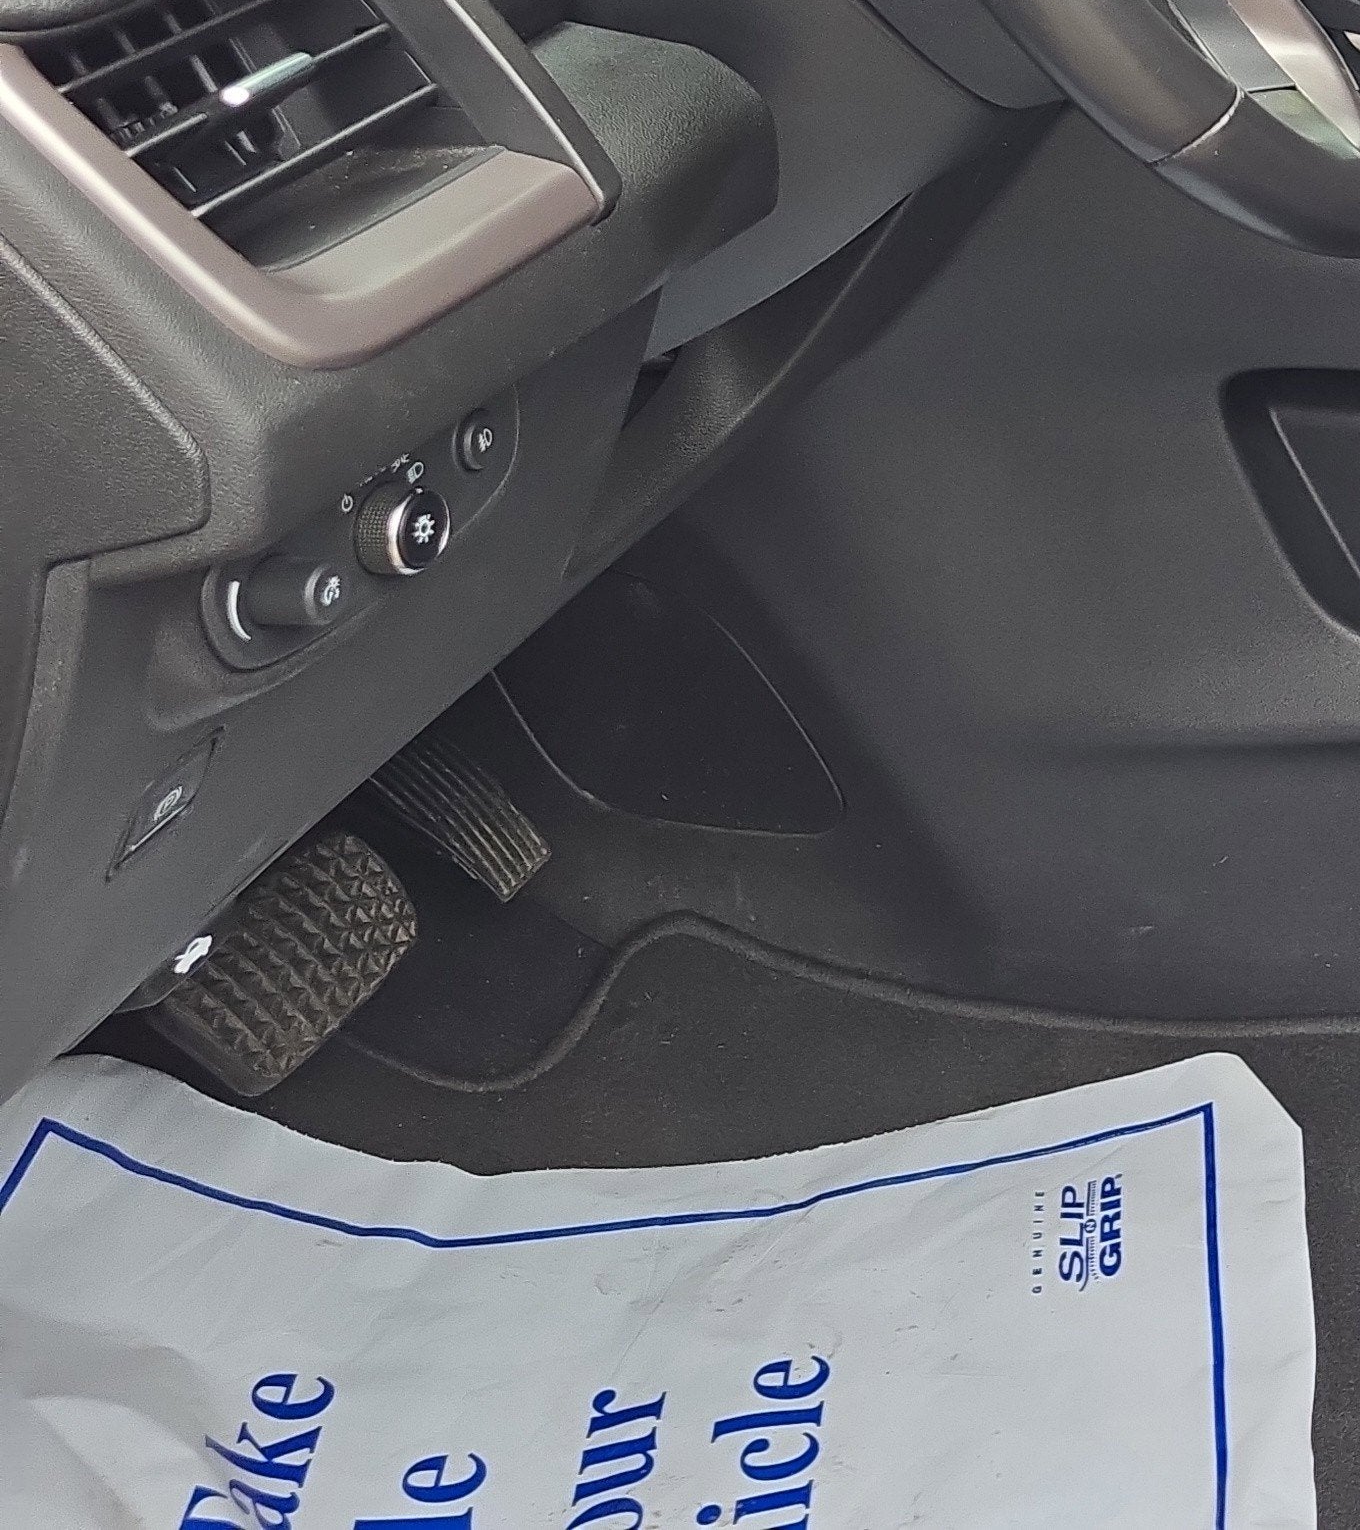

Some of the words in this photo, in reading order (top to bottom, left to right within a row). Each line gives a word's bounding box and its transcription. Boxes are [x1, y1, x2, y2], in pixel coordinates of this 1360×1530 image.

[1031, 1191, 1045, 1294] GENUINE
[1059, 1185, 1084, 1283] SLIP
[1099, 1176, 1122, 1277] GRIP
[696, 1355, 831, 1530] icle
